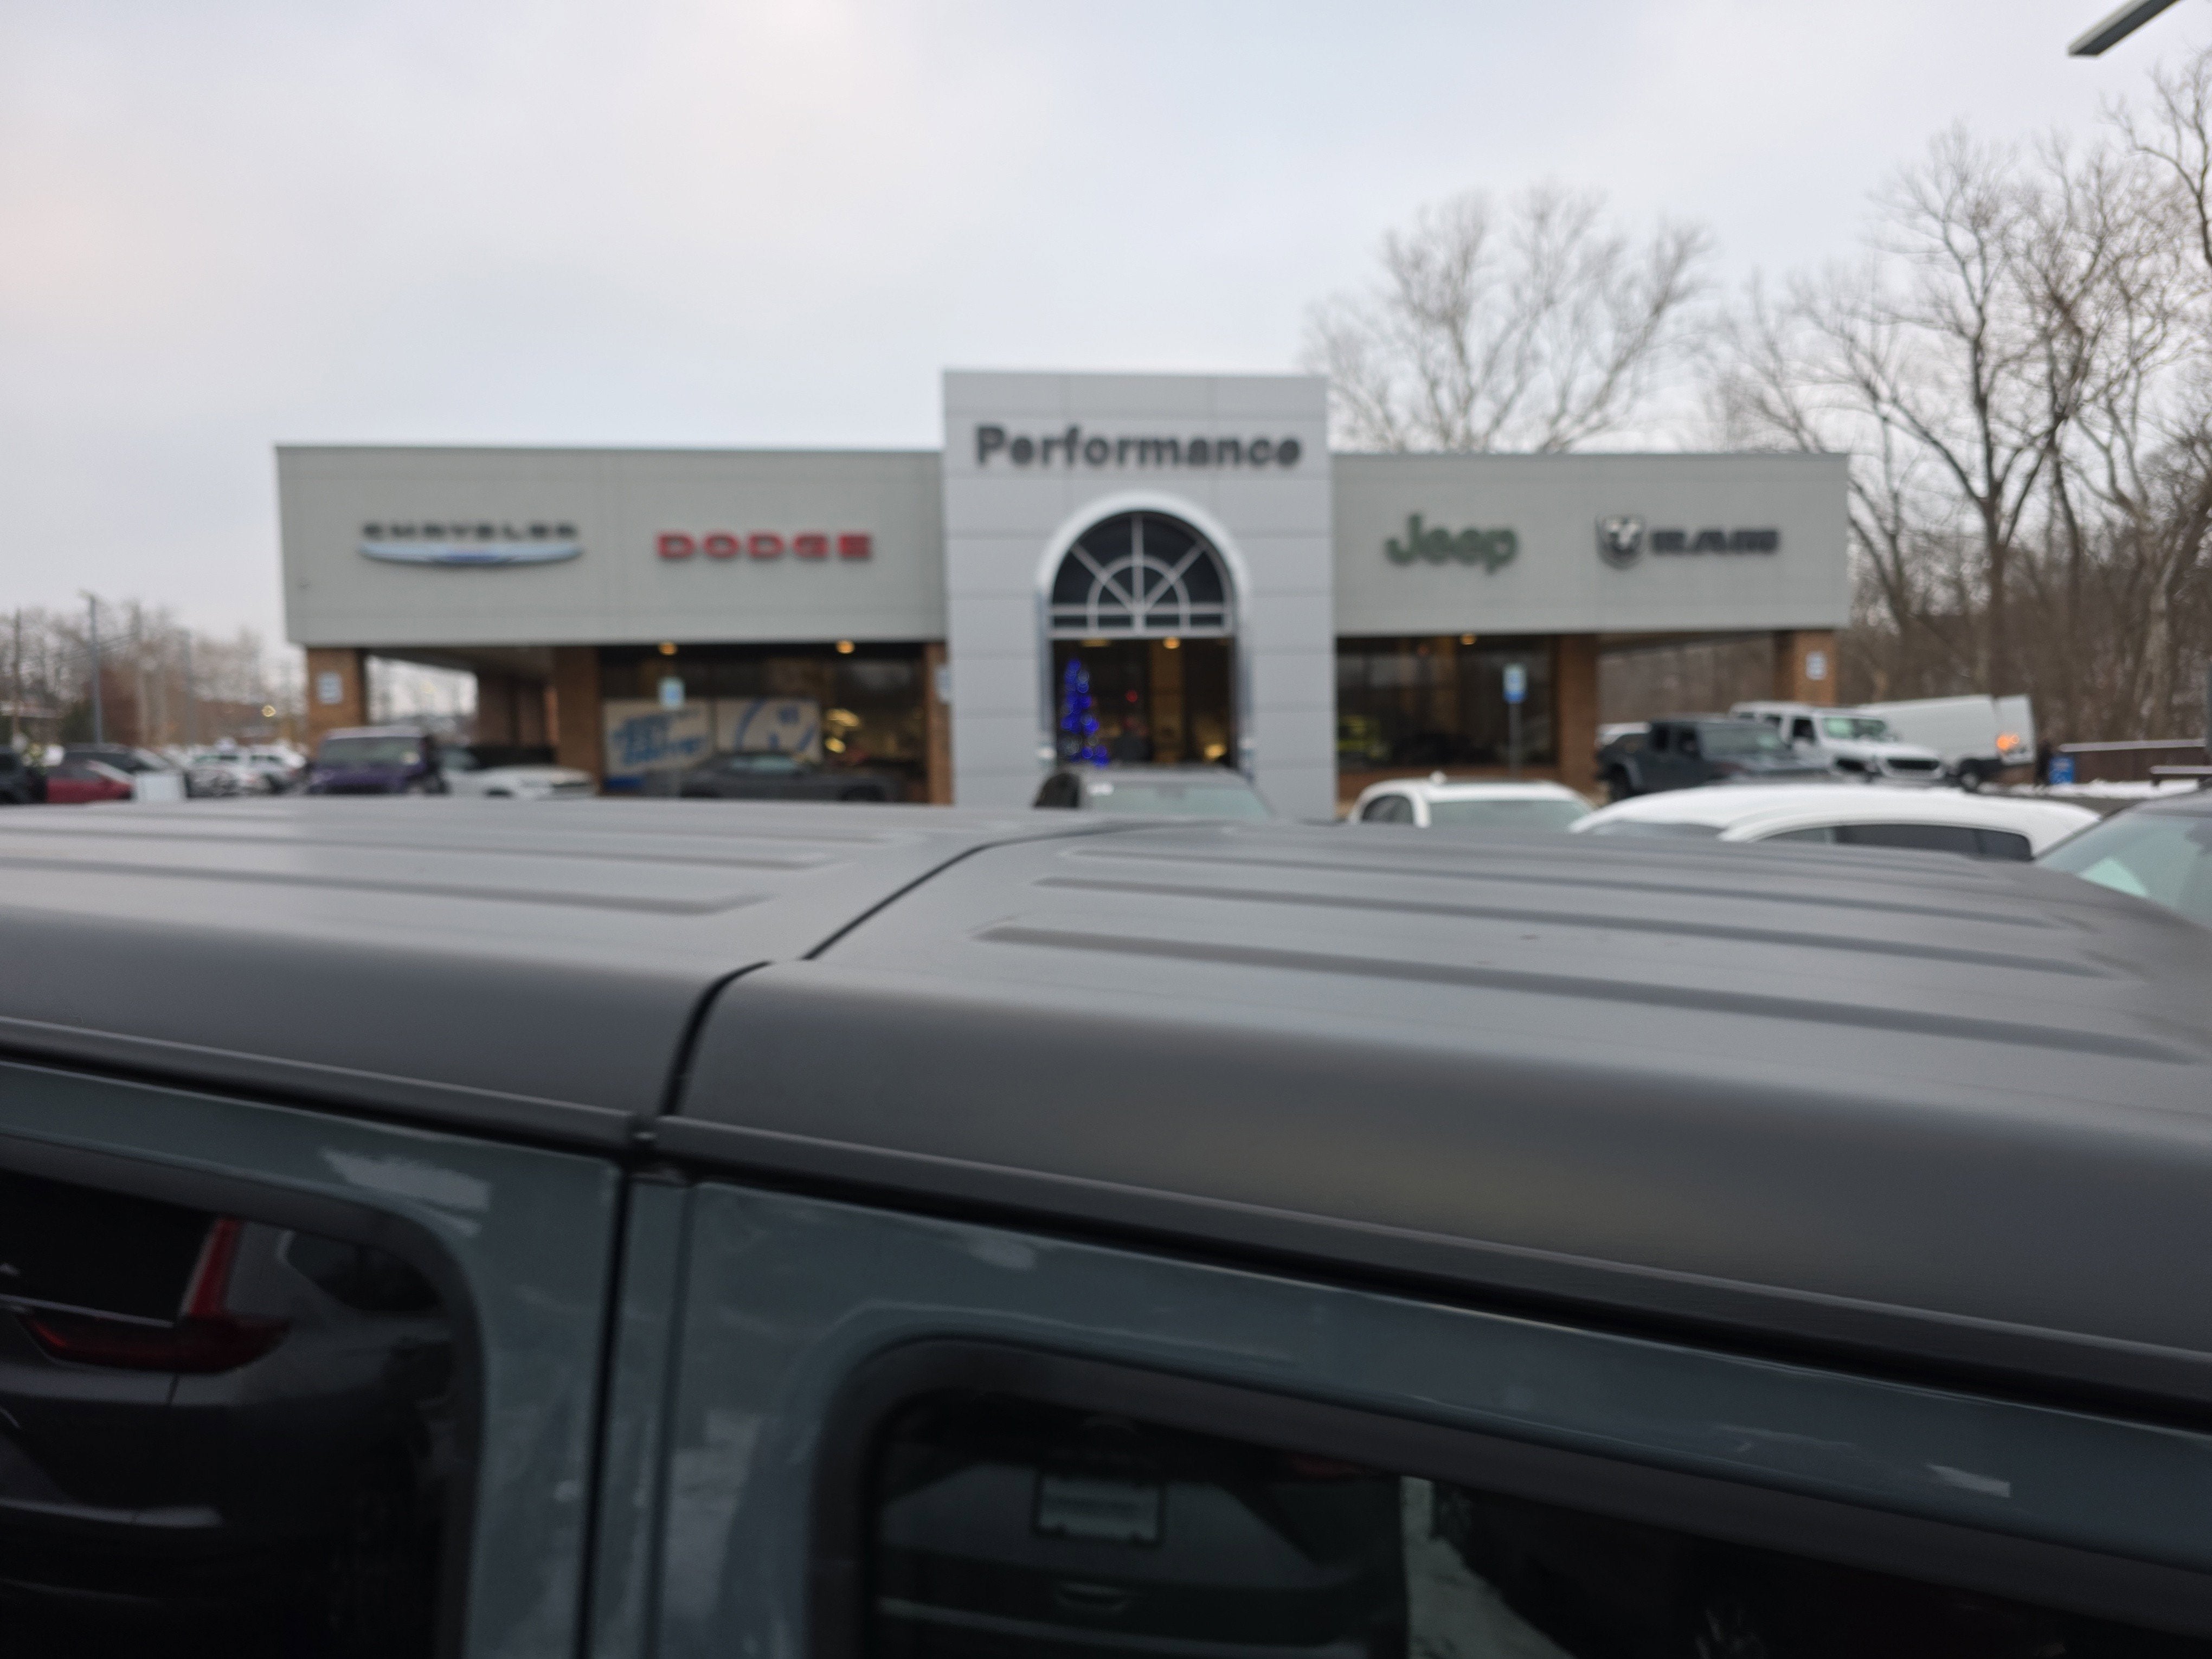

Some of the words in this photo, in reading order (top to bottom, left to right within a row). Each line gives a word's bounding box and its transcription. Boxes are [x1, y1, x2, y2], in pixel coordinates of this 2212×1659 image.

[976, 424, 1302, 468] Performance
[655, 532, 873, 560] DODGE
[1384, 512, 1519, 574] Jeep
[1650, 528, 1780, 556] RAM
